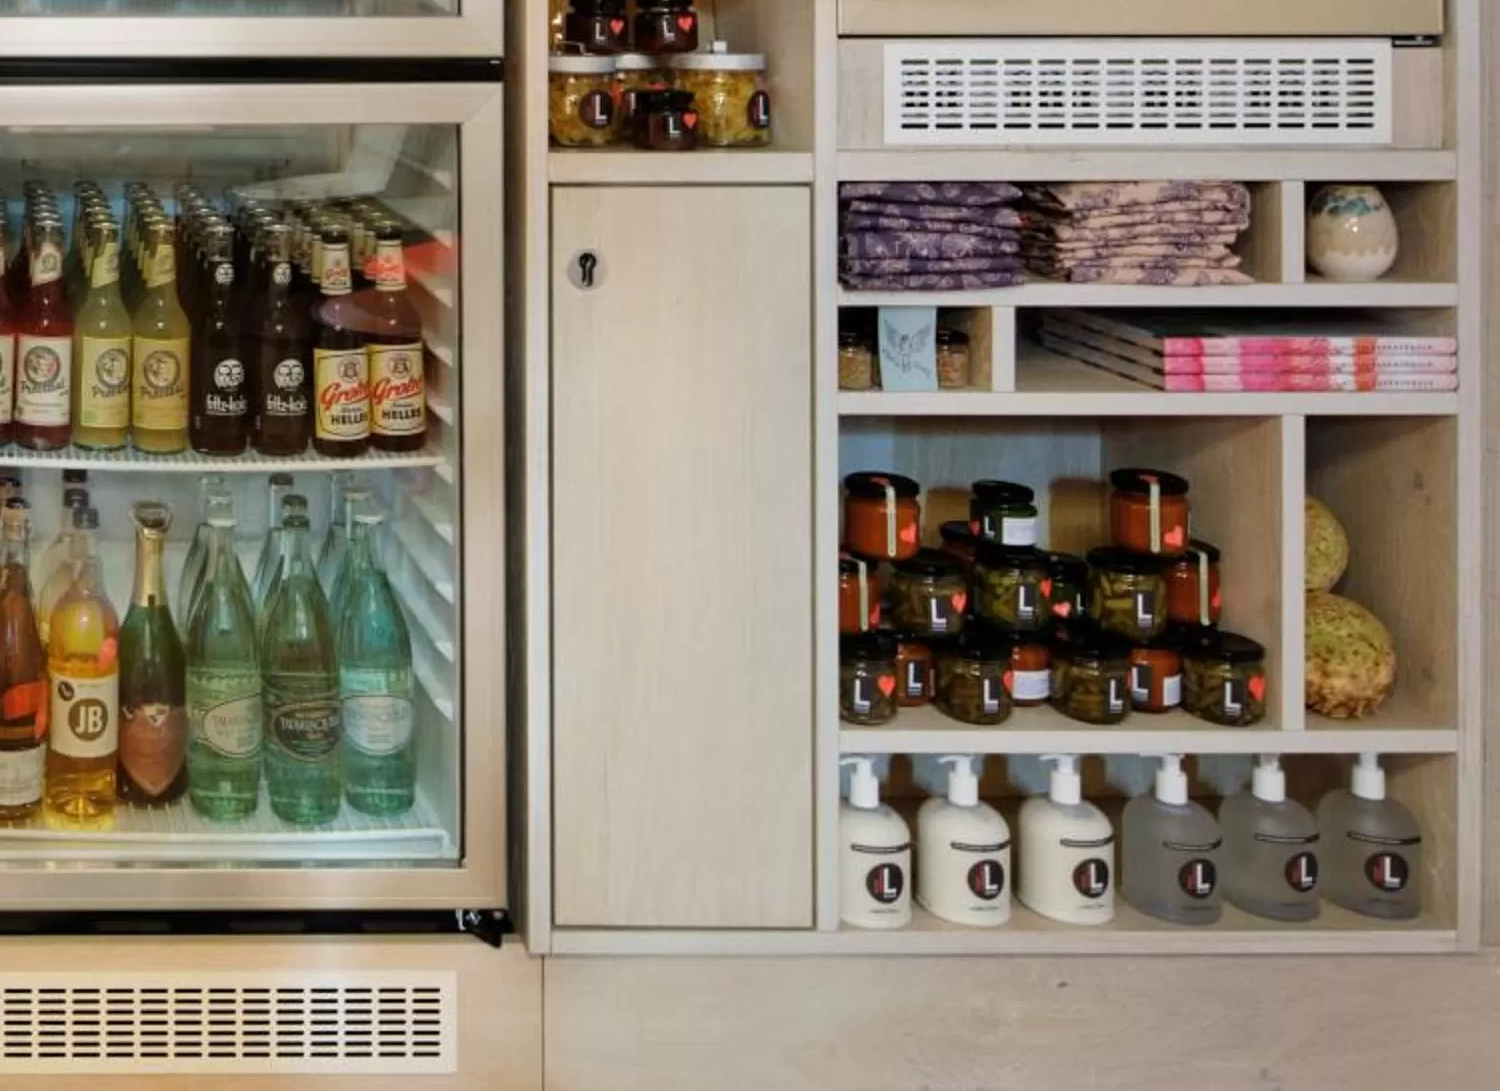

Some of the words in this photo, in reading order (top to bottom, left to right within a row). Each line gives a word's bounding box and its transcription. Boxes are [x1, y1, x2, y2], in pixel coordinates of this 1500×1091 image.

[931, 598, 947, 623] L
[1020, 586, 1033, 611] L
[1137, 593, 1152, 618] L
[908, 662, 922, 687] L
[1132, 667, 1148, 693] L
[854, 679, 870, 705] L
[984, 680, 998, 705] L
[1110, 679, 1123, 703] L
[1225, 681, 1241, 708] L
[77, 705, 103, 734] JB
[883, 868, 897, 894] L
[984, 865, 998, 889] L
[1090, 863, 1103, 888] L
[1196, 864, 1210, 889] L
[1384, 857, 1400, 882] L
